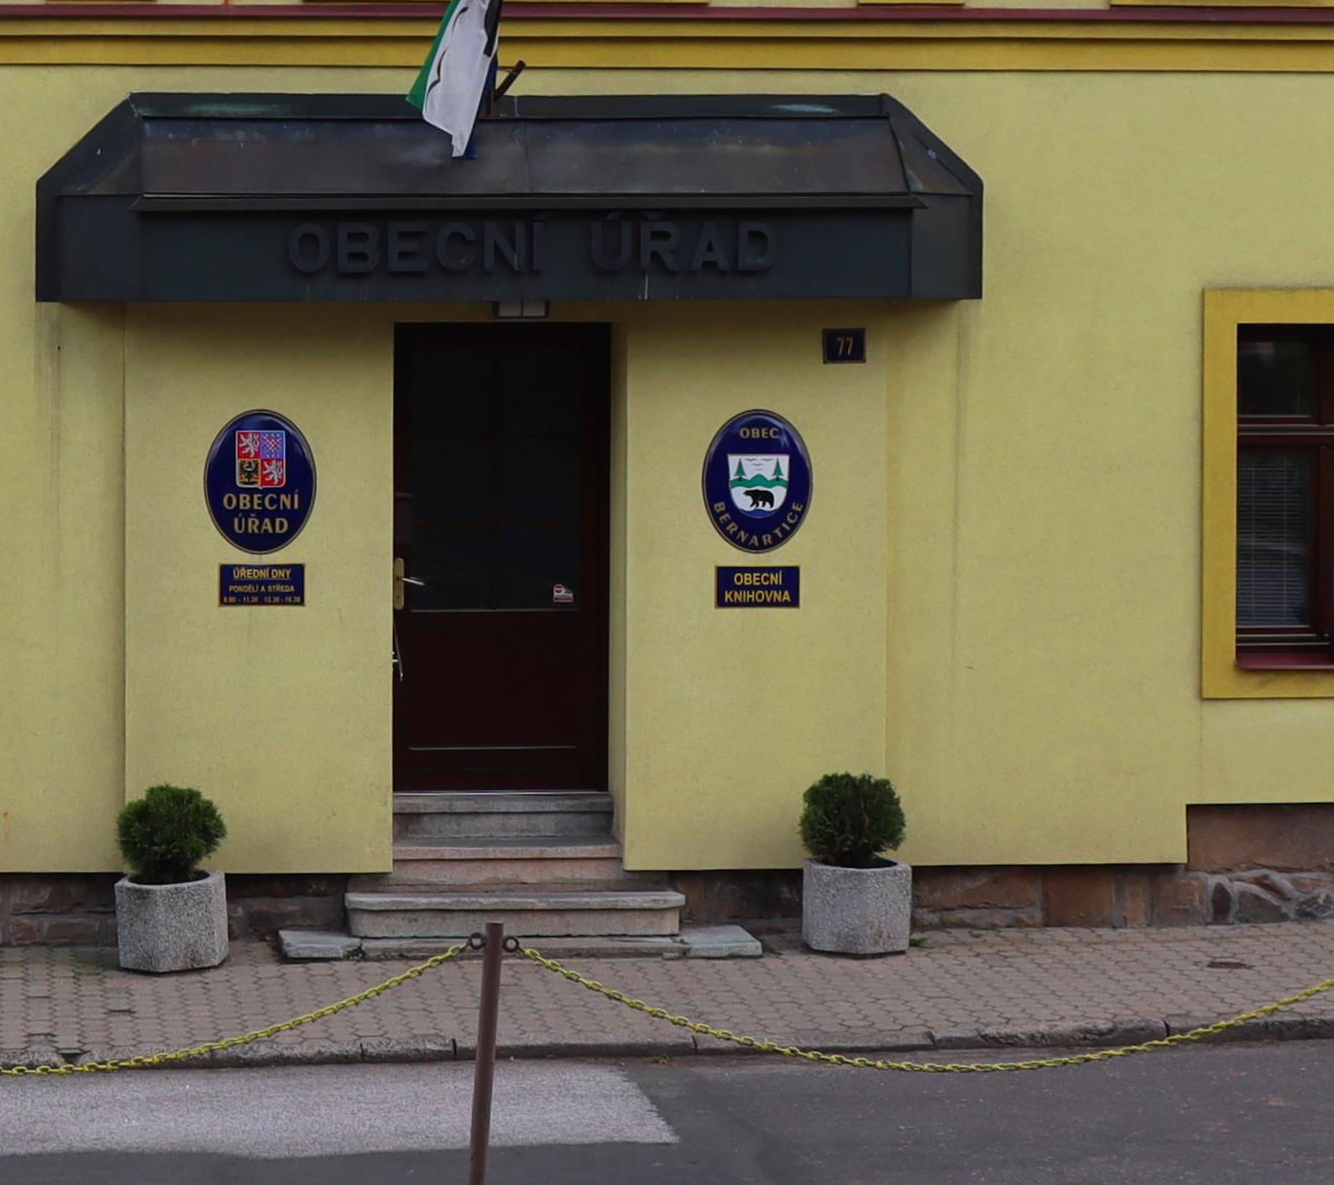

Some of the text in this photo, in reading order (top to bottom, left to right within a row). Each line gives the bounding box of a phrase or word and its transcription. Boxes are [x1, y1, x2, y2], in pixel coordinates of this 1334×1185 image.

[287, 211, 774, 273] OBECNÍ ÚŘAD
[739, 427, 780, 439] OBEC
[223, 488, 299, 510] OBECNÍ
[233, 512, 289, 534] ÚŘAD
[713, 501, 803, 546] BERNARTICE
[233, 567, 292, 579] ÚŘEDNÍ DNY
[733, 569, 783, 585] OBECNÍ
[260, 585, 266, 593] A
[724, 590, 792, 603] KNIHOVNA
